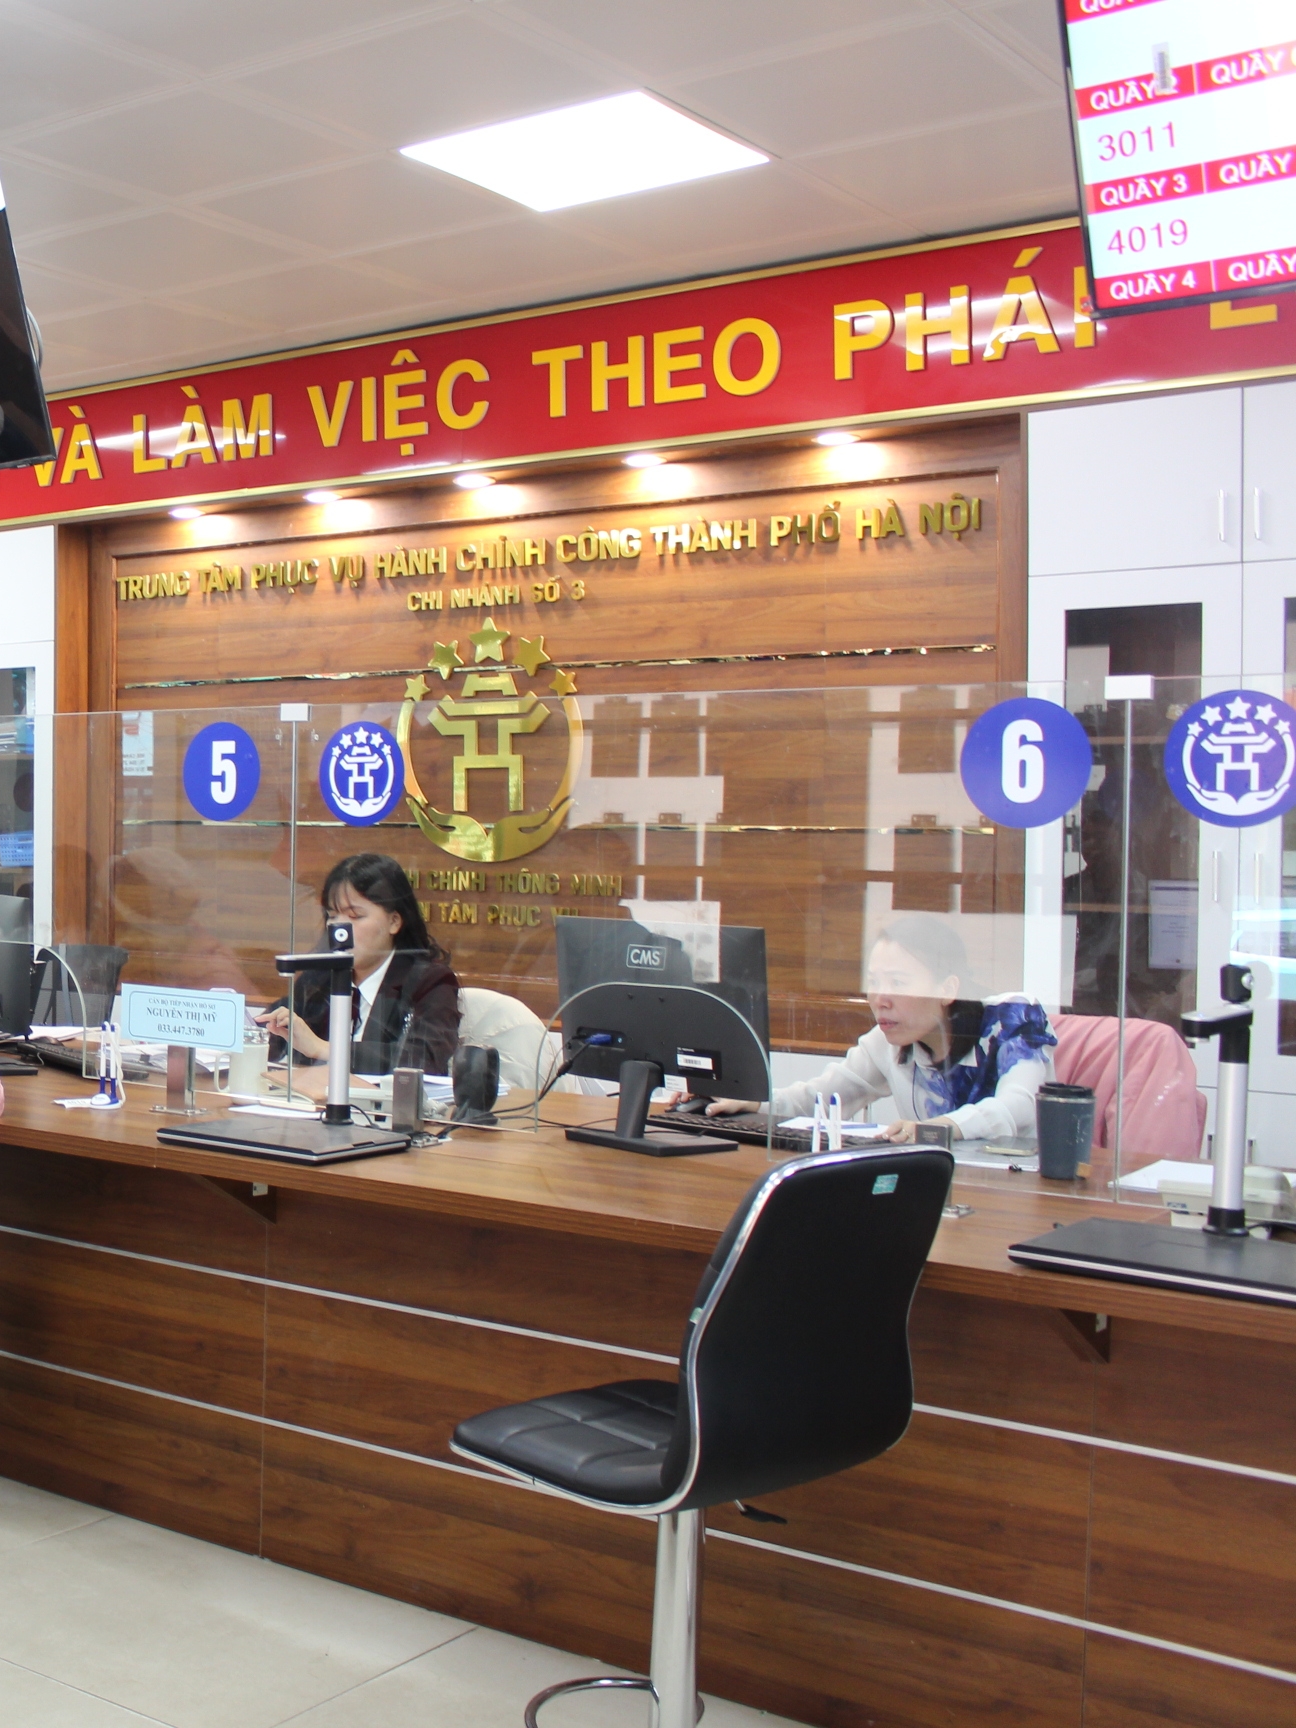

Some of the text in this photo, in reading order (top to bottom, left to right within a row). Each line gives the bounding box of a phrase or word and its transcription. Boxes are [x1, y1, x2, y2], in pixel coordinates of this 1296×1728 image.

[1210, 49, 1285, 85] QUẦY
[1097, 121, 1176, 162] 3011
[1218, 152, 1292, 185] QUẦY
[1099, 173, 1189, 207] QUẦY 3
[1107, 218, 1189, 255] 4019
[1109, 269, 1197, 300] QUẦY 4
[132, 386, 273, 474] LÀM
[306, 348, 490, 456] VIỆC
[532, 317, 782, 418] THEO
[116, 492, 981, 600] TRUNG TÂM PHỤC VỤ HÀNH CHÍNH CÔNG THÀNH PHỐ HÀ NỘI
[407, 575, 586, 612] CHI NHÁNH SỐ 3
[209, 740, 238, 805] 5
[1001, 718, 1045, 804] 6
[426, 866, 486, 892] CHÍNH
[494, 868, 560, 895] THÔNG
[570, 874, 622, 897] MINH
[438, 898, 478, 925] TÂM
[487, 903, 542, 931] PHỤC
[630, 948, 661, 966] CMS
[146, 1006, 183, 1019] NGUYỄN
[185, 1010, 201, 1023] THỊ
[157, 1022, 205, 1037] 033.447.3780
